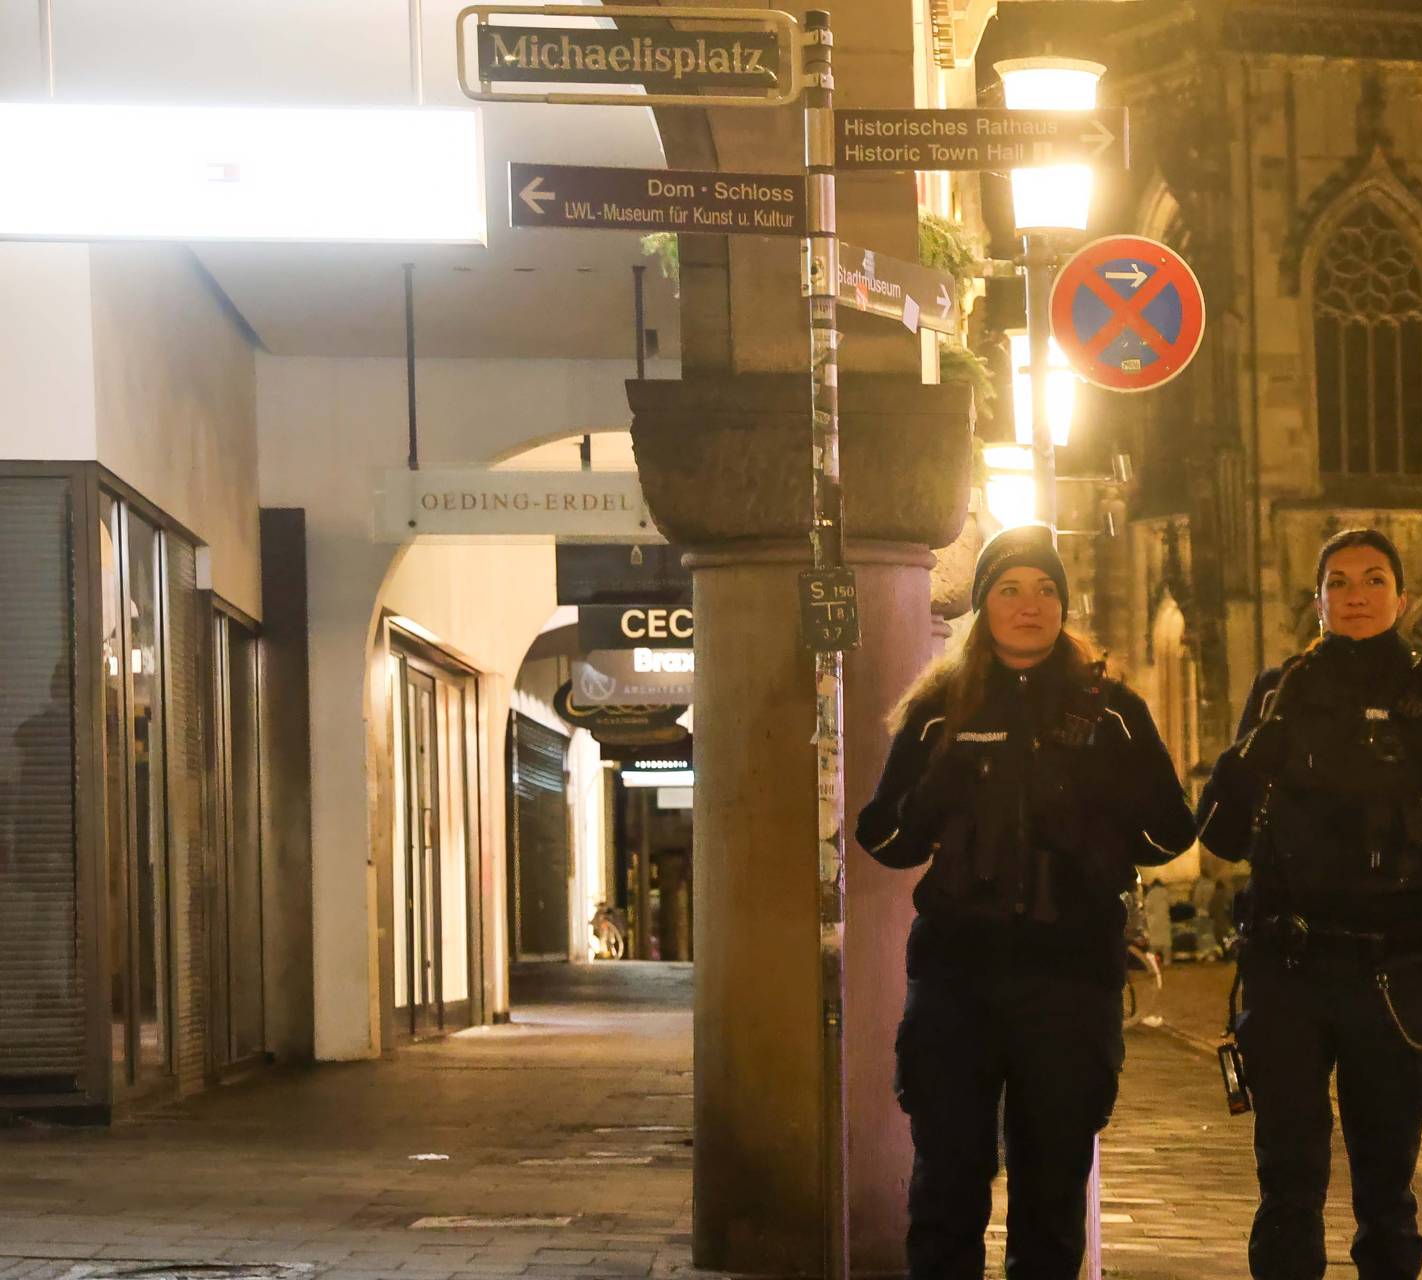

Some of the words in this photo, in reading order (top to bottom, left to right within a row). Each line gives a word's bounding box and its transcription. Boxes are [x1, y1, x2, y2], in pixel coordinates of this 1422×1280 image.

[490, 33, 768, 80] Michaelisplatz
[844, 119, 968, 136] Historisches
[976, 118, 1058, 136] Rathaus
[845, 144, 921, 162] Historic
[928, 144, 978, 161] Town
[987, 143, 1024, 161] Hall
[648, 179, 695, 198] Dom
[714, 182, 794, 202] Schloss
[669, 206, 689, 224] für
[693, 208, 733, 226] Kunst
[738, 212, 750, 226] u.
[754, 209, 794, 227] Kultur
[838, 264, 901, 298] Stadtmuseum
[421, 493, 633, 511] OEDING-ERDEL
[620, 608, 694, 639] CEC
